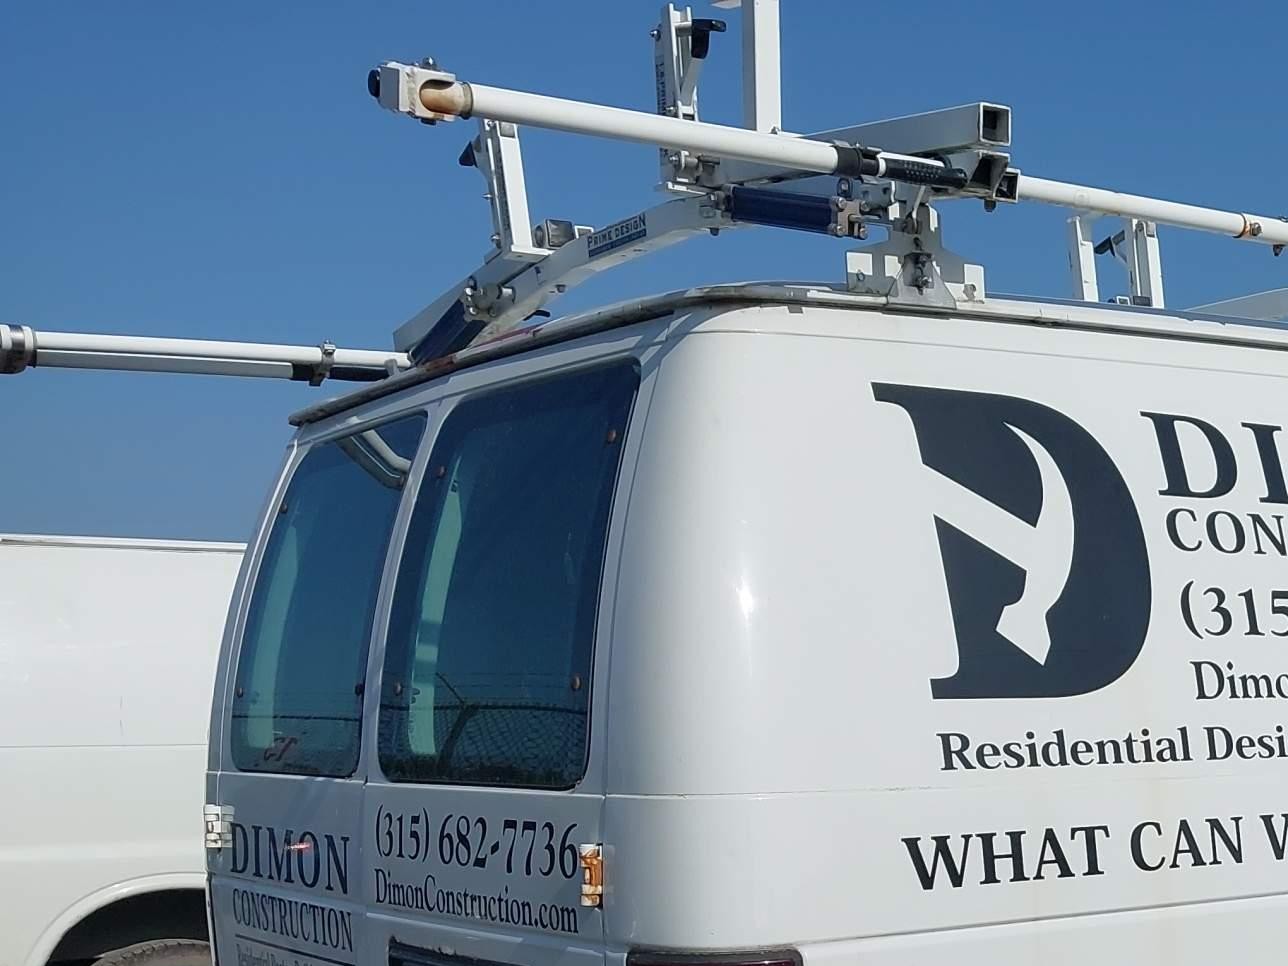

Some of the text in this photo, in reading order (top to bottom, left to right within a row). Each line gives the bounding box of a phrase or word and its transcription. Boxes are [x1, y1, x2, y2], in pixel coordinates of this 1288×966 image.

[614, 212, 646, 239] DESIGN
[936, 726, 1193, 771] Residential
[230, 822, 350, 895] DIMON
[375, 804, 578, 879] (315) 682-7736
[901, 825, 1110, 891] WHAT
[1130, 816, 1243, 872] CAN
[232, 888, 353, 952] CONSTRUCTION
[374, 868, 579, 934] DimonConstruction.com
